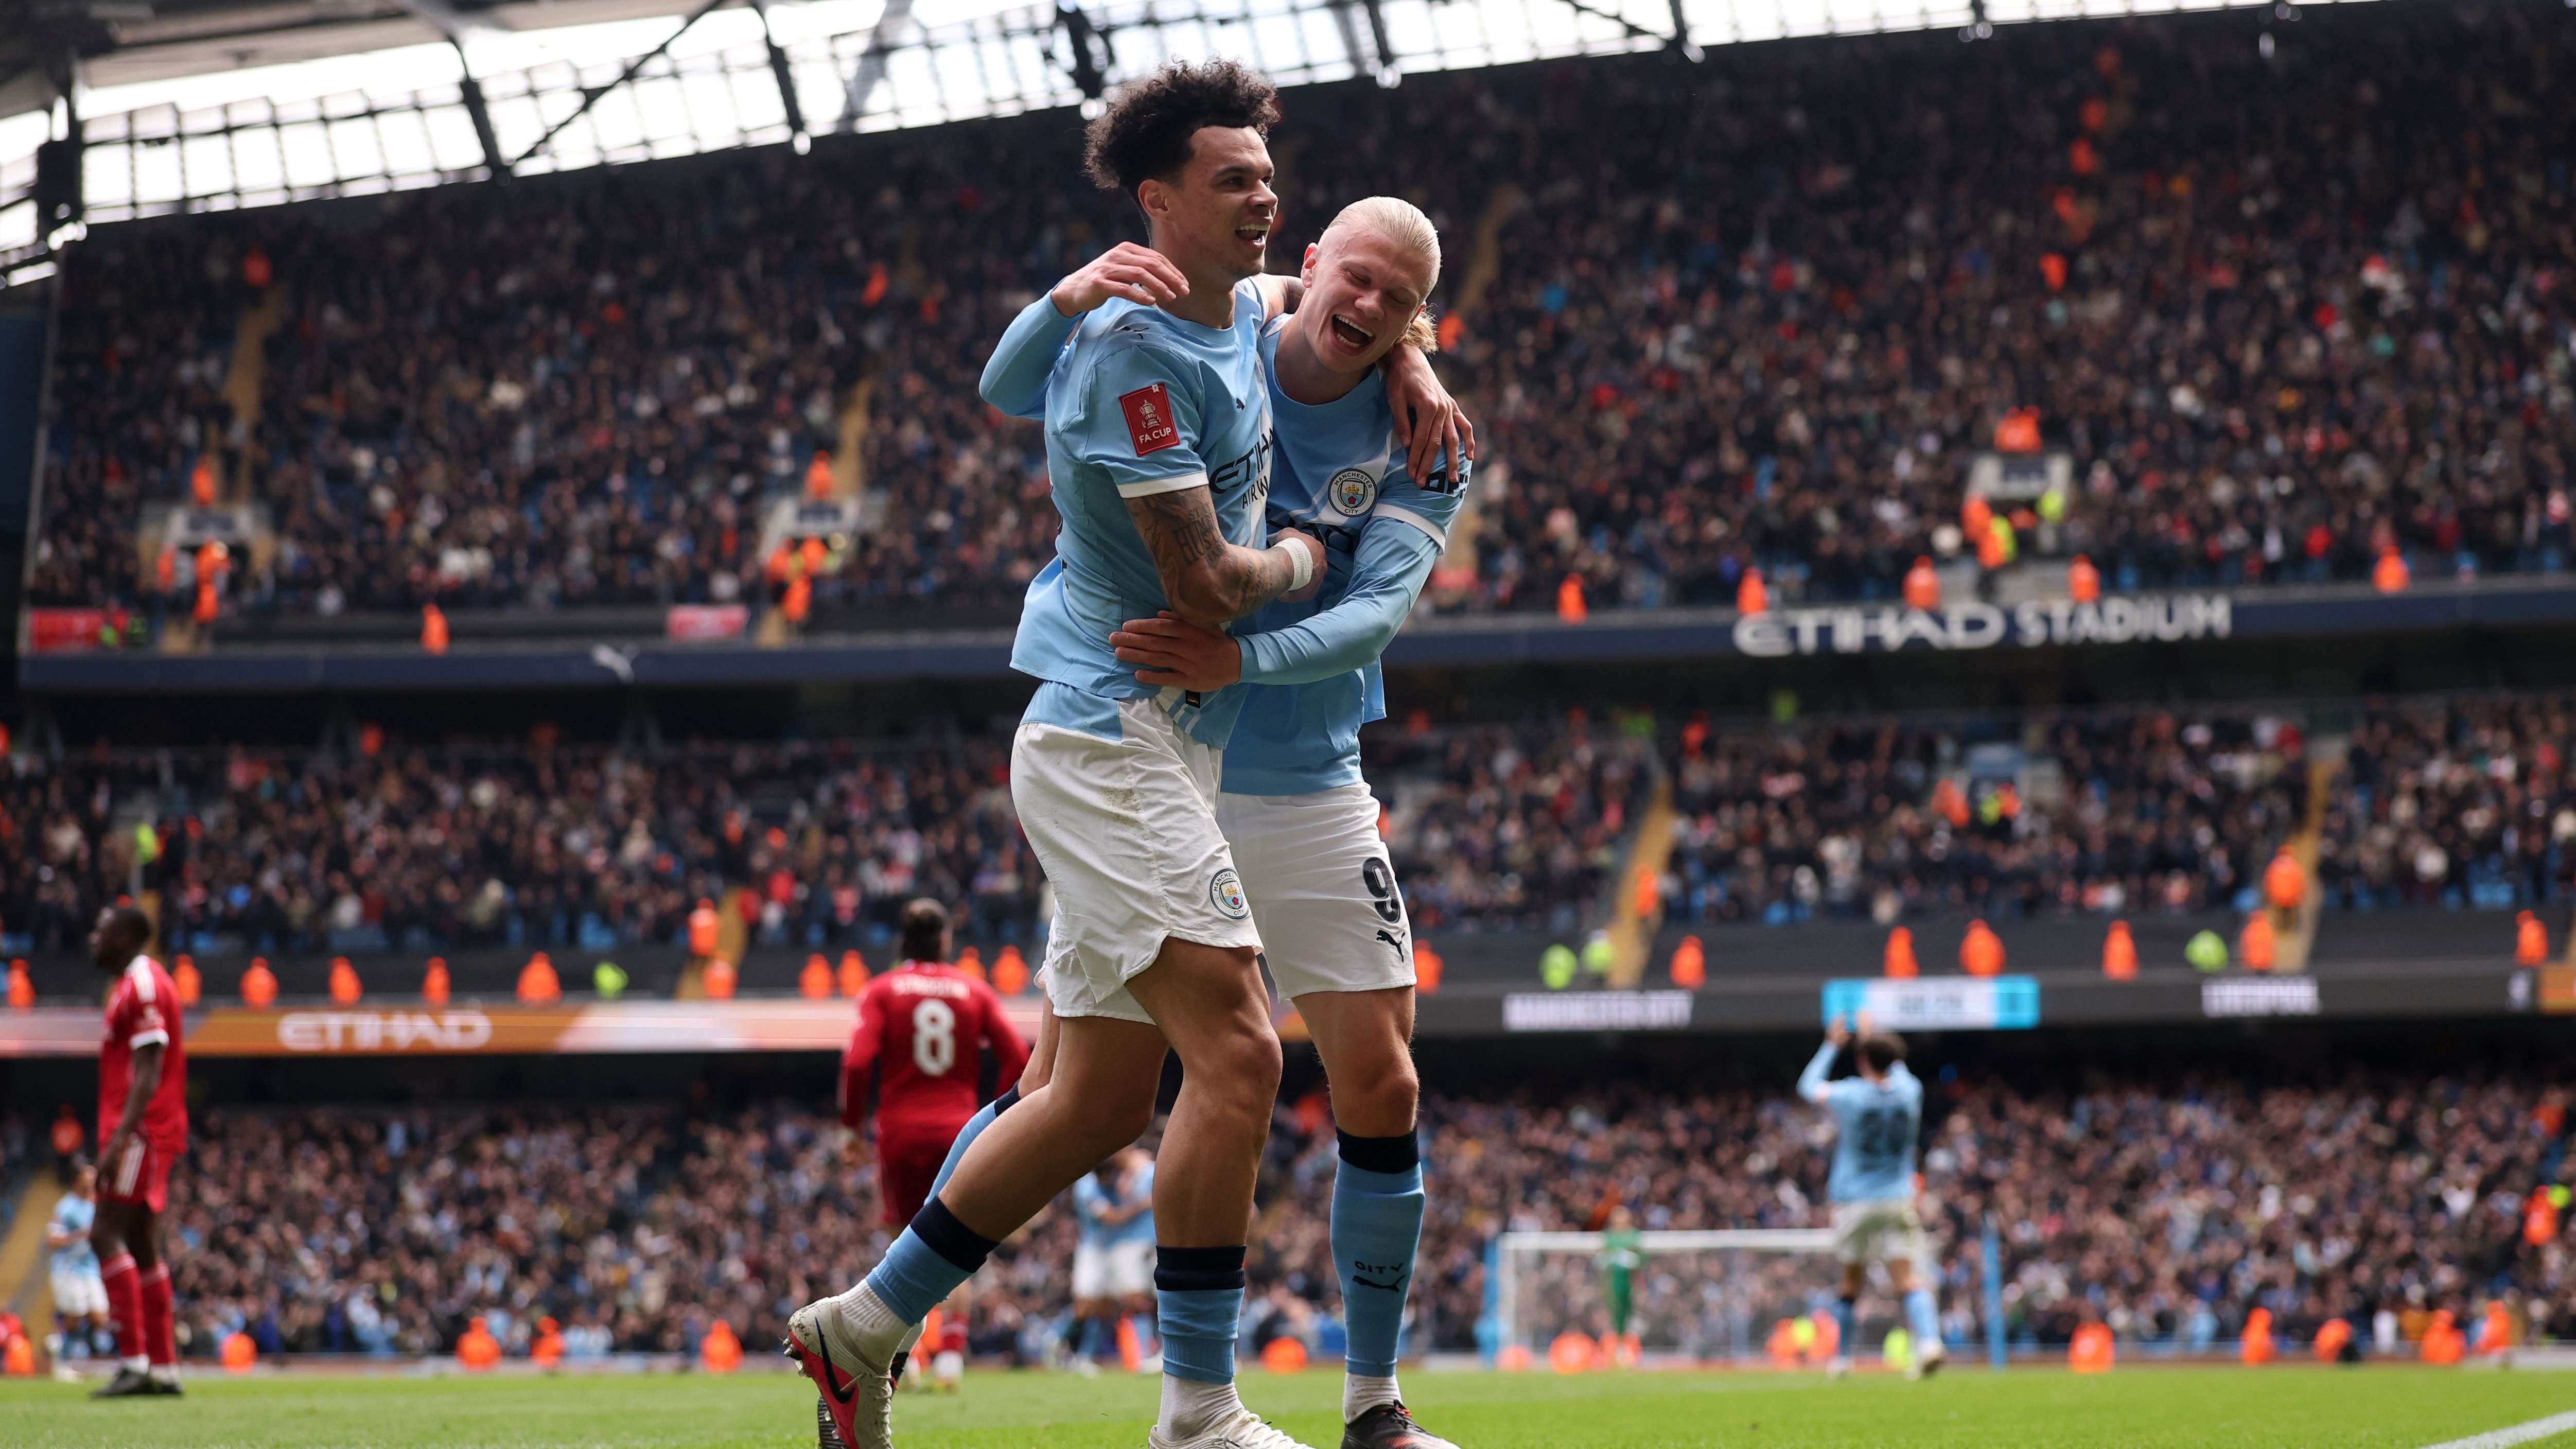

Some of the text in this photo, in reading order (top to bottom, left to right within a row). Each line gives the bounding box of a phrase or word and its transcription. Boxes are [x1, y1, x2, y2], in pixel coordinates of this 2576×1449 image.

[1139, 427, 1171, 444] FA CUP
[1242, 476, 1269, 509] AIRW
[1334, 472, 1373, 489] MANCHESTER
[1732, 594, 2231, 657] ETIHAD STADIUM
[1362, 857, 1401, 923] 9
[277, 1010, 494, 1050] ETIHAD
[913, 998, 955, 1077] 8
